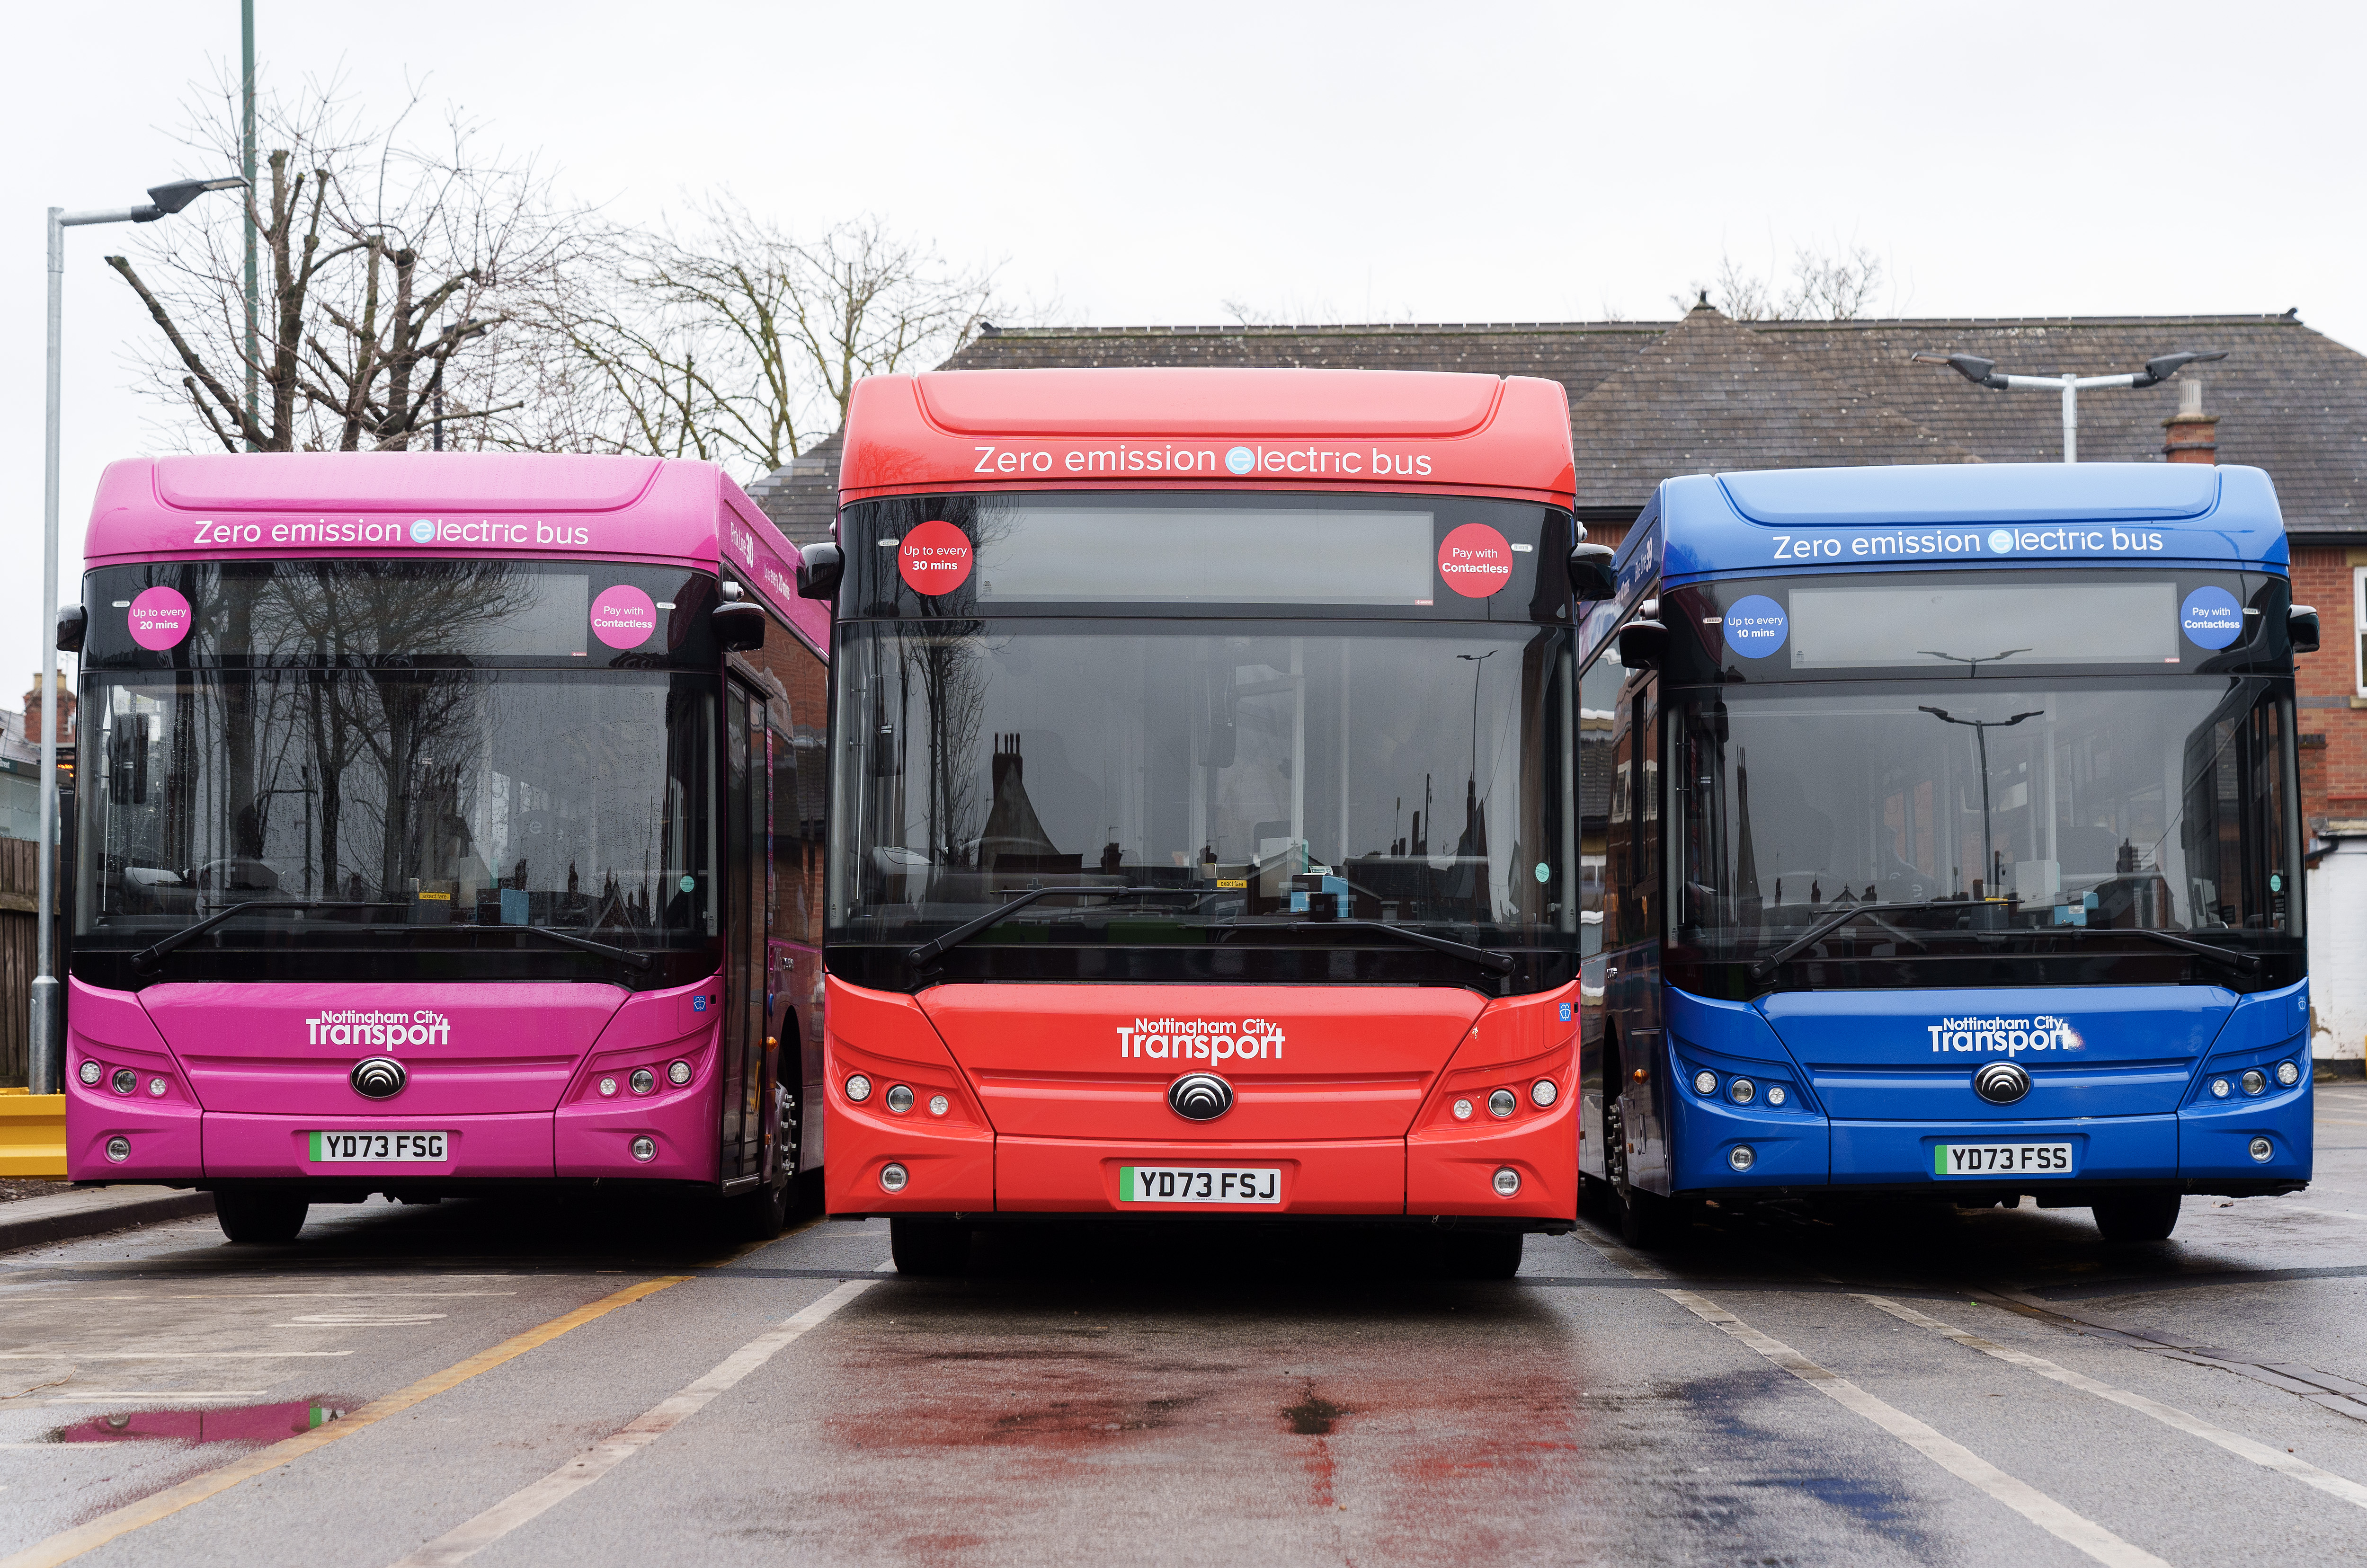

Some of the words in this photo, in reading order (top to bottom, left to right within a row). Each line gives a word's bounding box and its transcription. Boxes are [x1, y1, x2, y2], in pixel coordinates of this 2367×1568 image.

[974, 446, 1053, 473] Zero
[1065, 444, 1216, 471] emission
[1225, 446, 1362, 475] electric
[1372, 447, 1432, 476] bus
[194, 520, 261, 543] Zero
[271, 519, 401, 542] emission
[409, 519, 527, 544] electric
[536, 520, 588, 545] bus
[730, 522, 739, 548] Pink
[746, 532, 753, 568] 30
[904, 546, 919, 558] Up
[922, 546, 934, 555] to
[936, 548, 967, 558] every
[1772, 536, 1842, 559] Zero
[1851, 530, 1980, 555] emission
[1988, 528, 2105, 554] electric
[2111, 527, 2163, 550] bus
[1453, 548, 1473, 560] Pay
[1475, 549, 1498, 558] with
[1646, 537, 1653, 572] 39
[912, 560, 927, 570] 30
[931, 560, 958, 570] mins
[1442, 562, 1509, 573] Contactless
[778, 572, 783, 593] 20
[1620, 581, 1624, 601] 10
[133, 608, 146, 619] Up
[160, 609, 187, 618] every
[604, 606, 621, 617] Pay
[623, 607, 643, 615] with
[2193, 607, 2209, 618] Pay
[2211, 607, 2231, 616] with
[140, 620, 153, 629] 20
[155, 620, 178, 629] mins
[594, 618, 653, 628] Contactless
[1728, 617, 1742, 628] Up
[1744, 617, 1754, 625] to
[1757, 617, 1783, 626] every
[2184, 620, 2240, 629] Contactless
[1737, 629, 1749, 638] 10
[1752, 628, 1775, 638] mins
[321, 1010, 409, 1028] Nottingham
[413, 1010, 444, 1028] City
[1135, 1018, 1237, 1039] Nottingham
[1242, 1019, 1277, 1038] City
[1943, 1017, 2029, 1035] Nottingham
[2034, 1016, 2063, 1031] City
[305, 1019, 451, 1051] Transport
[1928, 1023, 2071, 1057] Transport
[1117, 1027, 1285, 1066] Transport
[327, 1136, 388, 1157] YD73
[396, 1135, 442, 1157] FSG
[1952, 1148, 2013, 1170] YD73
[2021, 1147, 2067, 1169] FSS
[1140, 1172, 1212, 1197] YD73
[1221, 1173, 1275, 1198] FSJ
